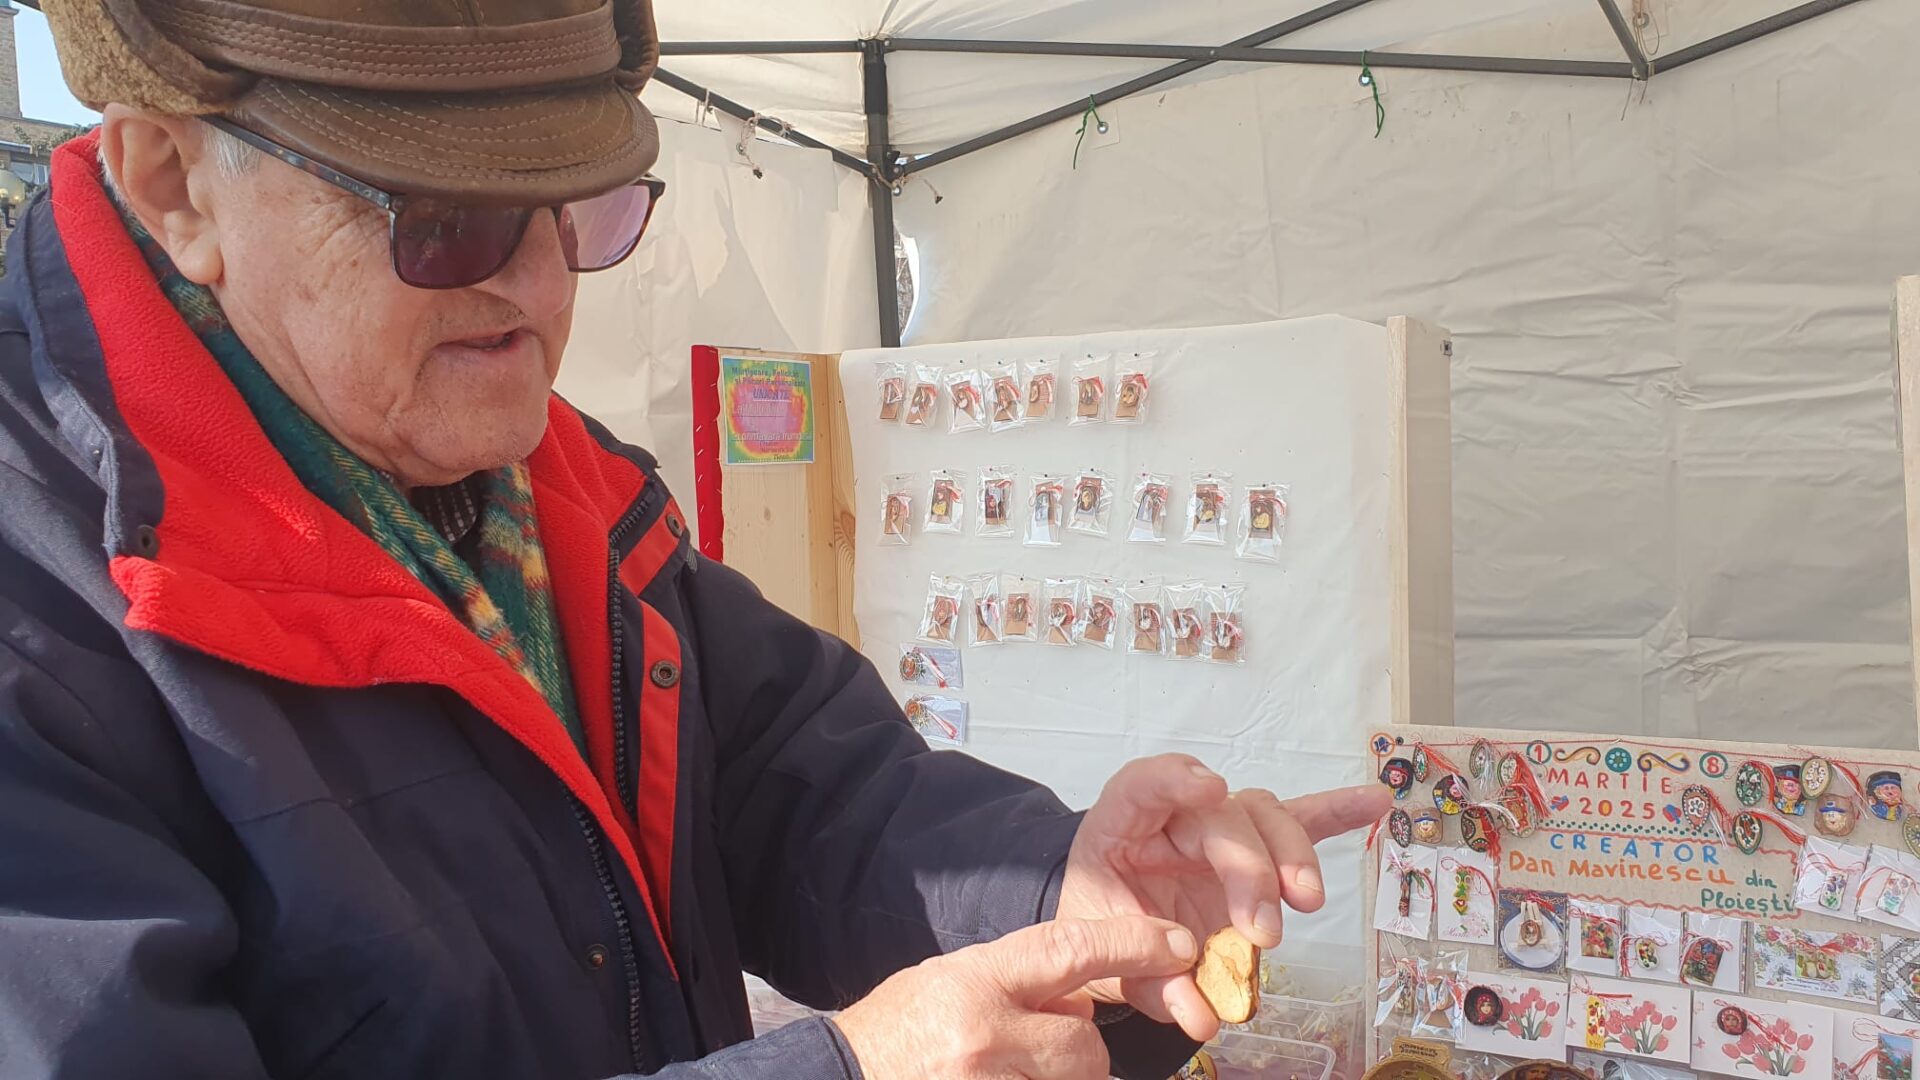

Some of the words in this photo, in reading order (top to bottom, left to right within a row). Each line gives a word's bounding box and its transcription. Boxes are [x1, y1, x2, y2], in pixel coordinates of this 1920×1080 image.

[1534, 744, 1543, 763] 1
[1707, 756, 1721, 775] 8
[1579, 797, 1656, 820] 2025
[1550, 833, 1720, 865] CREATOR
[1509, 850, 1555, 877] Dan
[1745, 869, 1777, 889] din
